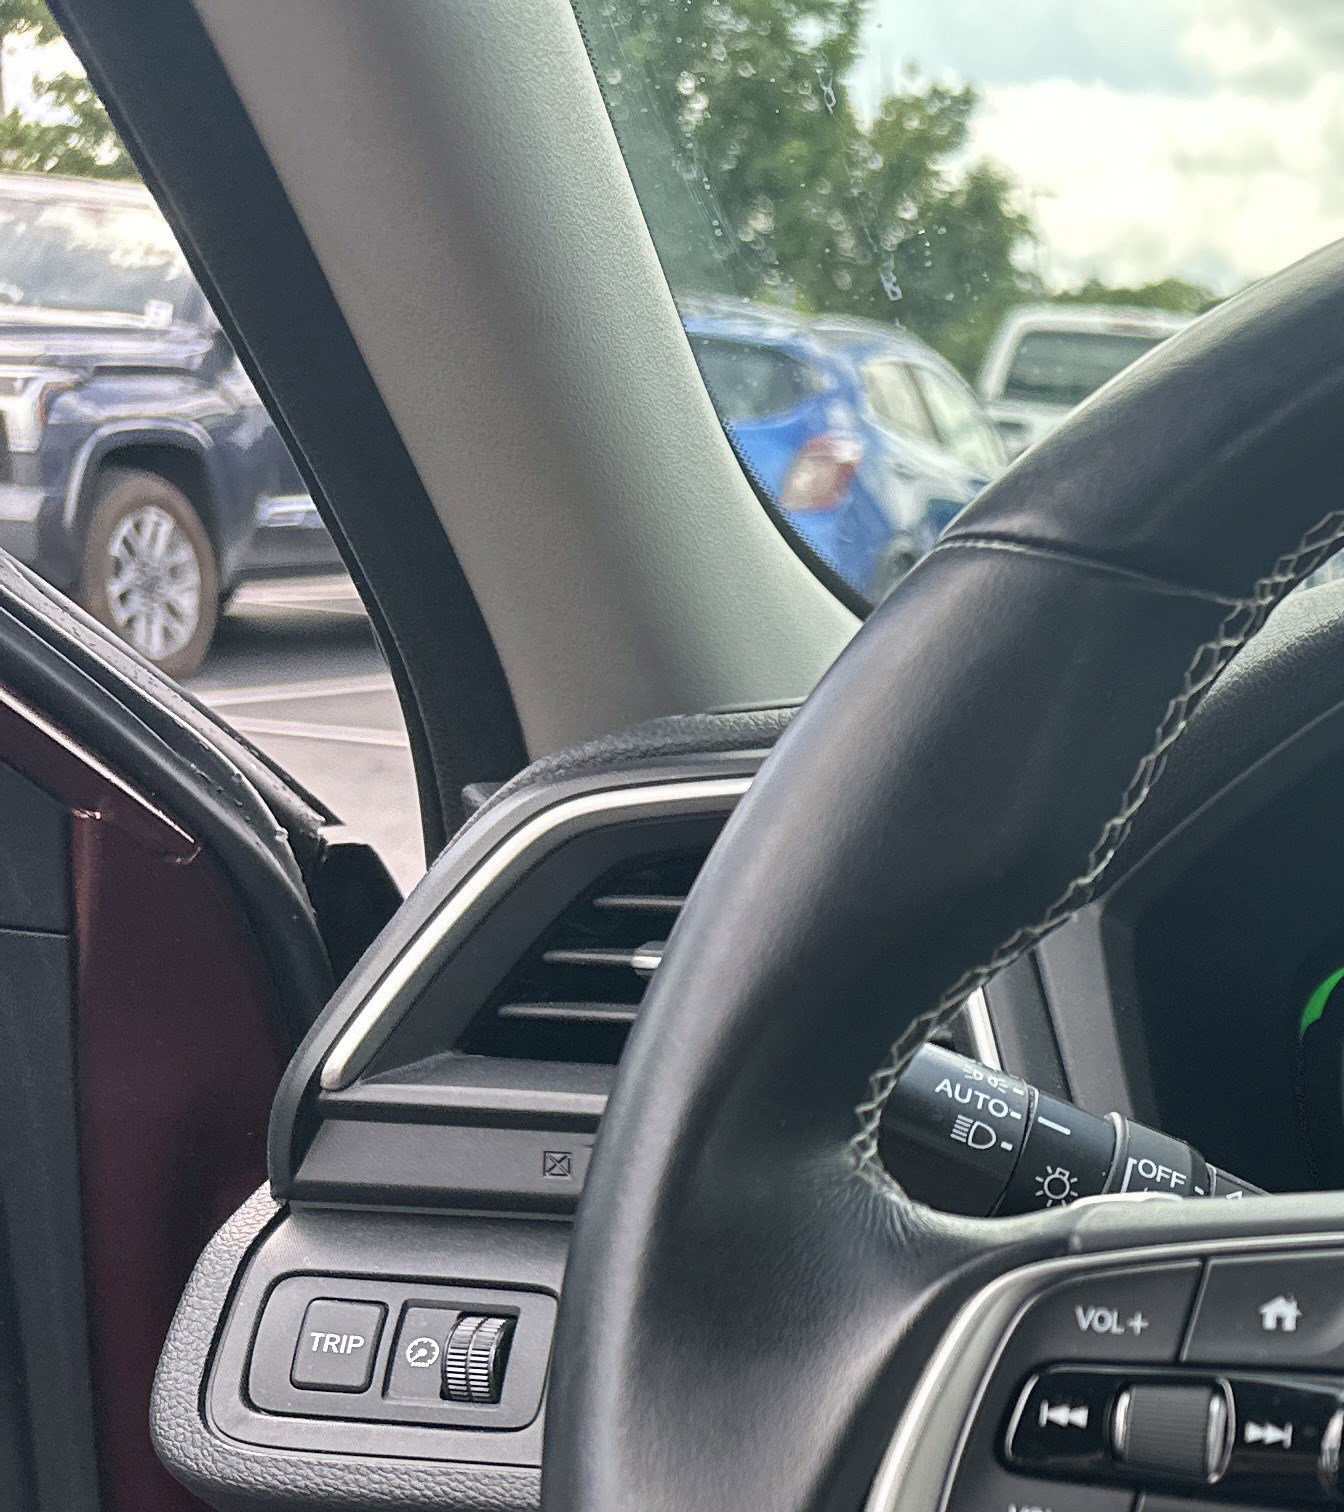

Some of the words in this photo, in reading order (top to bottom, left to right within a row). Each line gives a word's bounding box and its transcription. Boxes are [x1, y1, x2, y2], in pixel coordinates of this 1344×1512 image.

[935, 1078, 1008, 1118] AUTO
[1137, 1158, 1187, 1189] OFF
[310, 1331, 364, 1354] TRIP
